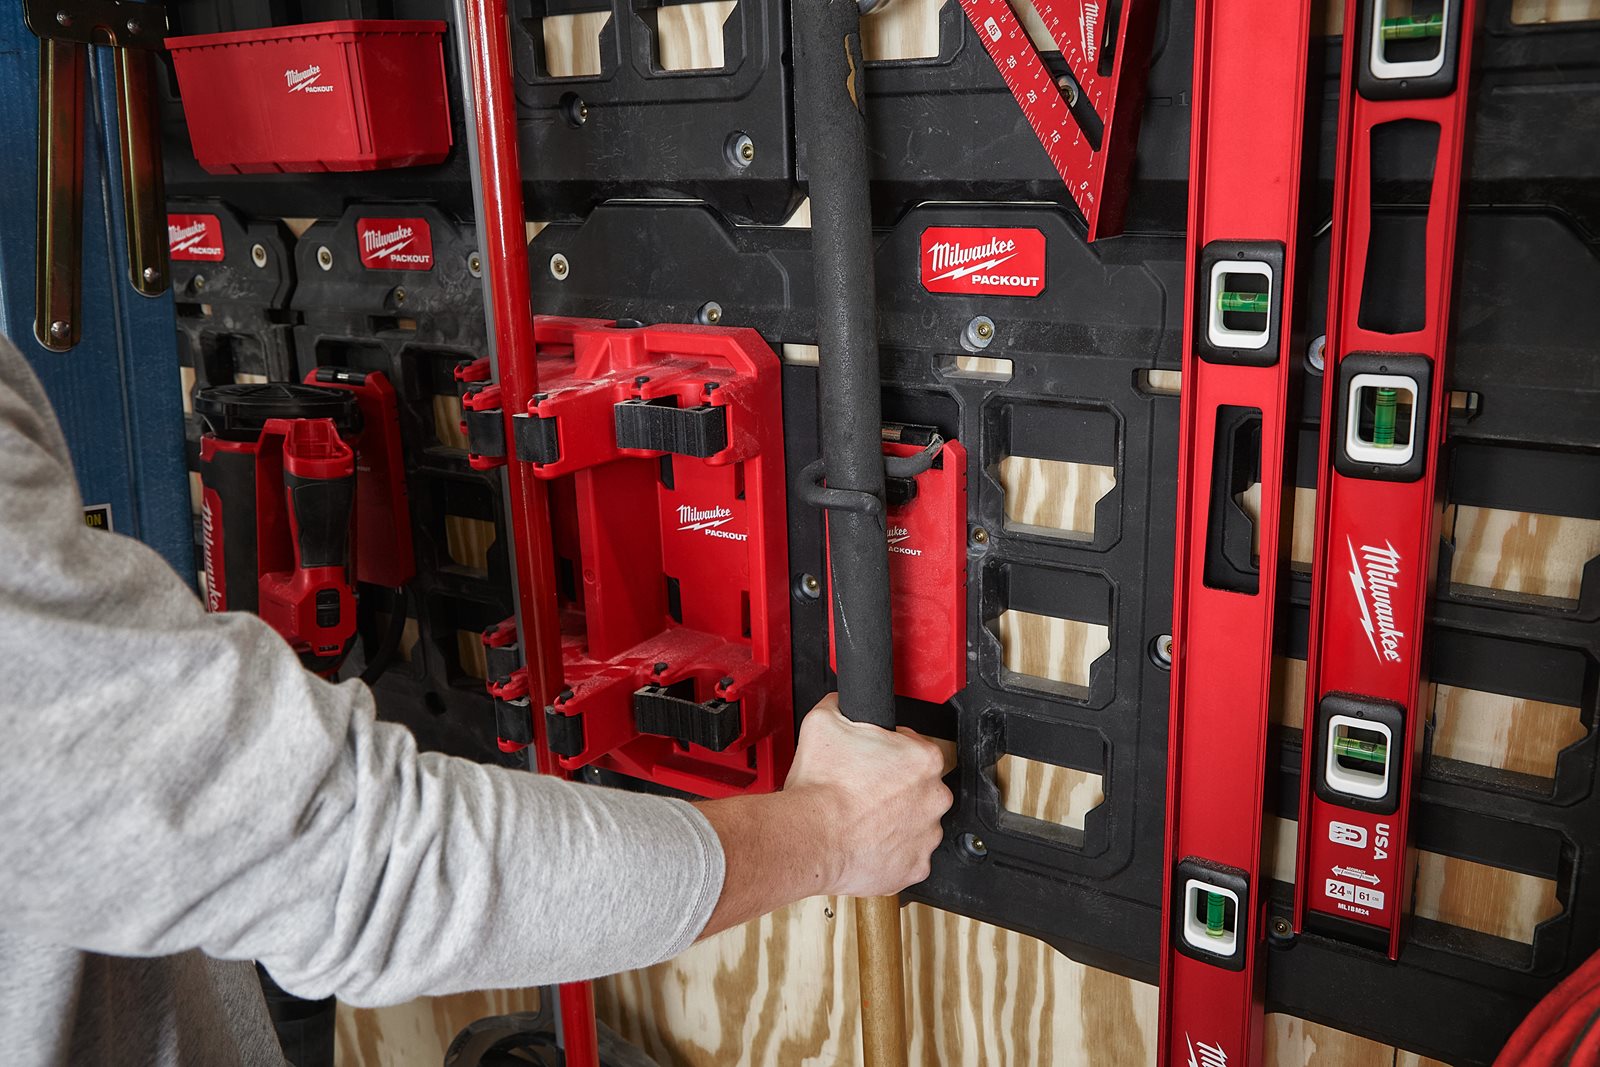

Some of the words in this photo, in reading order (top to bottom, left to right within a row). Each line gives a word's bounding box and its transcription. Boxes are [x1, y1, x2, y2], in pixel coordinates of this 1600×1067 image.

[988, 24, 998, 36] 45
[1084, 0, 1099, 63] Milwaukee
[1006, 55, 1017, 69] 35
[284, 65, 320, 87] Milwaukee
[1026, 90, 1037, 103] 25
[1050, 130, 1061, 143] 15
[1080, 181, 1089, 190] 5
[361, 225, 413, 253] Milwaukee
[390, 254, 429, 263] PACKOUT
[927, 237, 1015, 272] Milwaukee
[972, 275, 1039, 287] PACKOUT
[676, 504, 732, 524] Milwaukee
[704, 529, 748, 541] PACKOUT
[202, 497, 222, 613] Milwauke
[888, 546, 922, 556] ACKOUT
[1360, 539, 1403, 661] Milwaukee
[1374, 823, 1390, 860] USA
[1329, 883, 1345, 897] 24
[1359, 891, 1370, 902] 61
